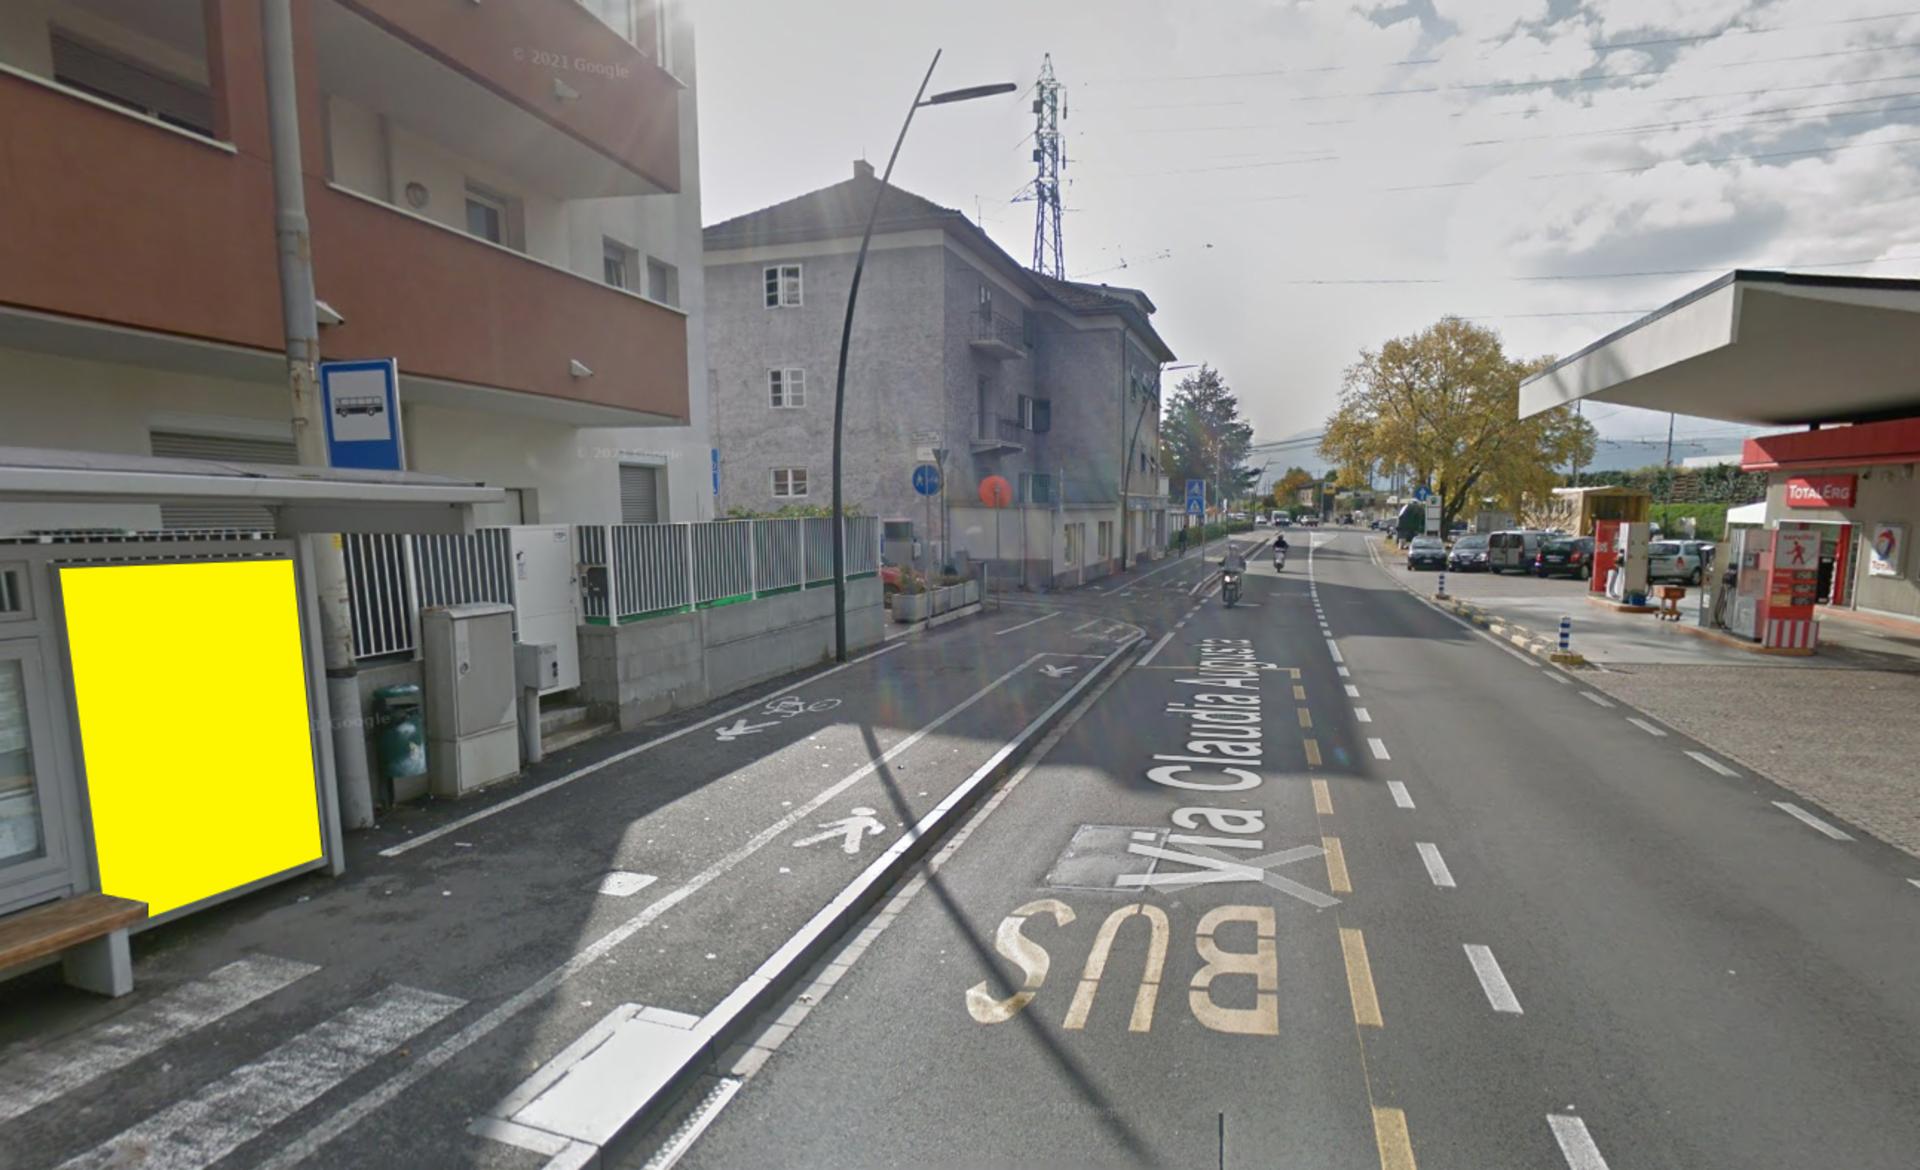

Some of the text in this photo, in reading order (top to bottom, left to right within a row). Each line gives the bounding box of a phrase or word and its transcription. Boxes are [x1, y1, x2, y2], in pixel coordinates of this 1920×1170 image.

[1115, 639, 1278, 887] Via Claudia Augusta
[965, 898, 1280, 1036] BUS
